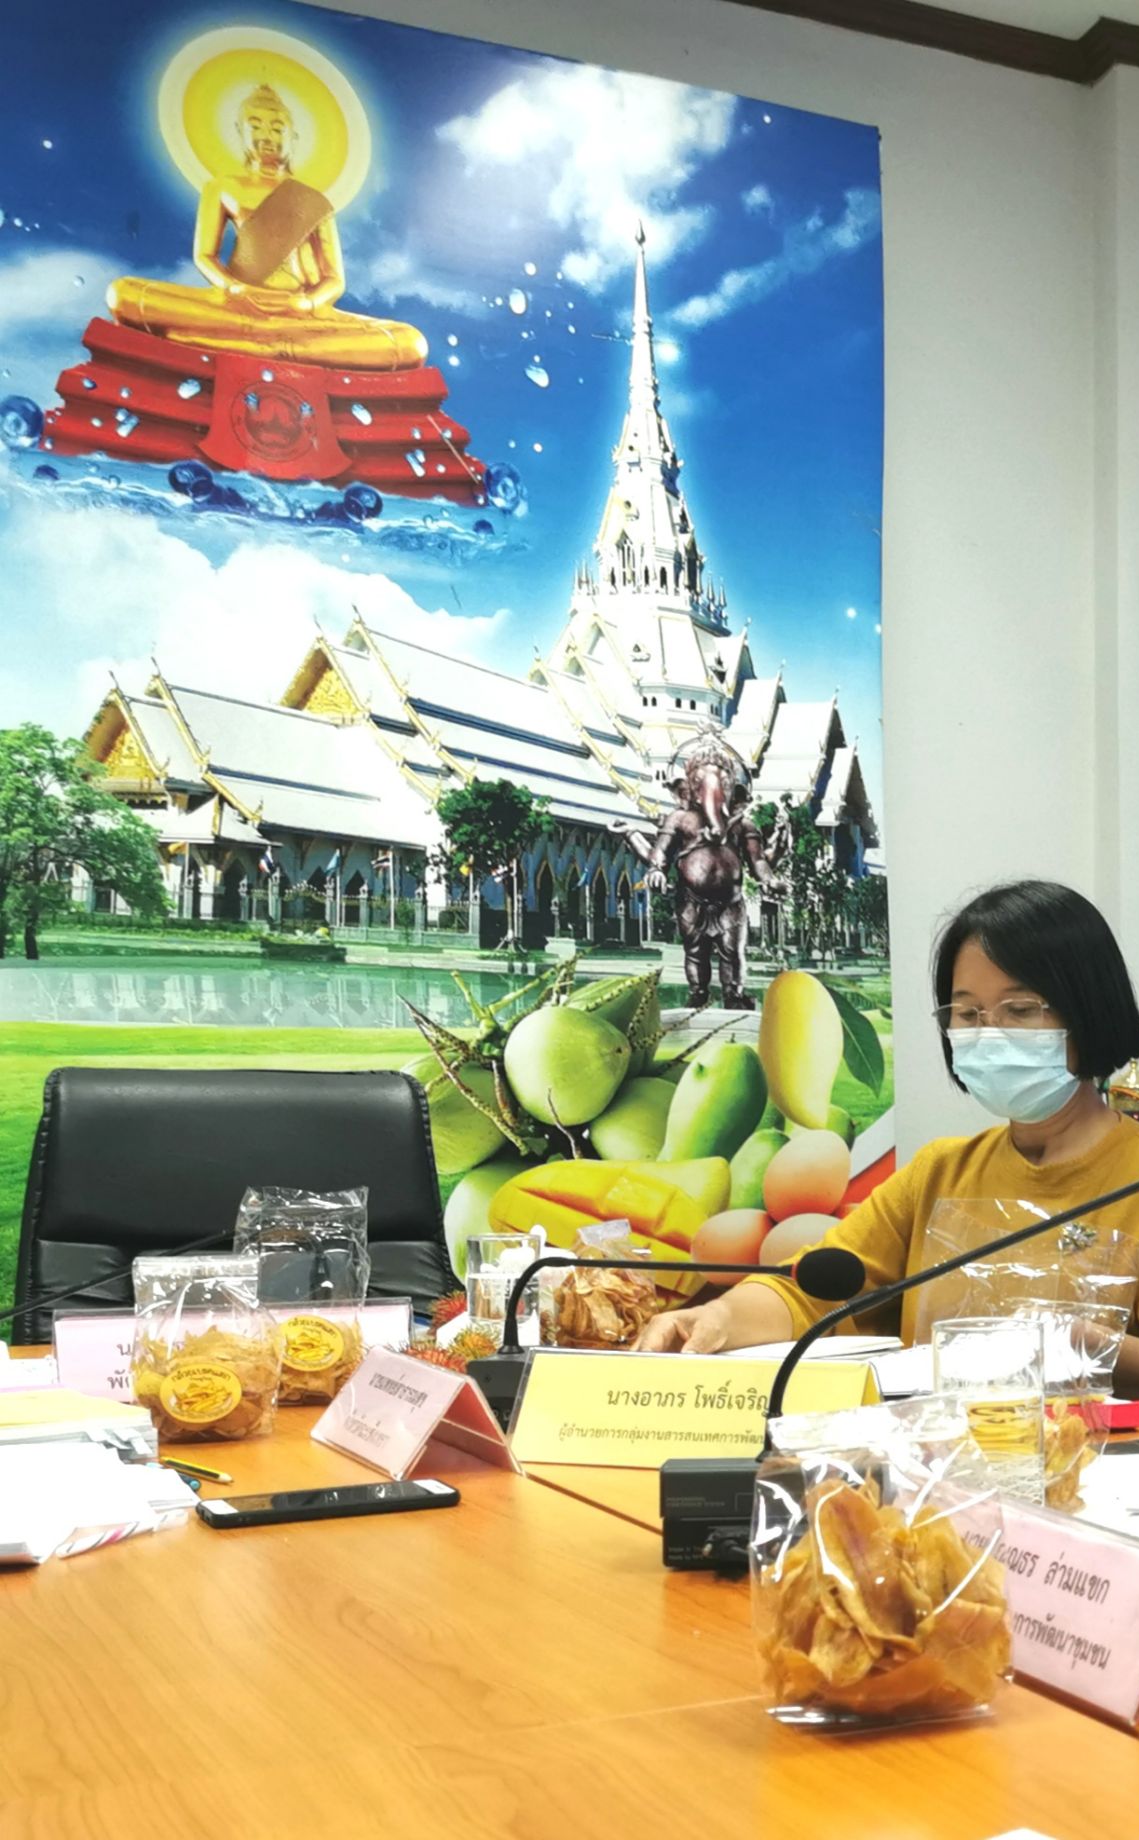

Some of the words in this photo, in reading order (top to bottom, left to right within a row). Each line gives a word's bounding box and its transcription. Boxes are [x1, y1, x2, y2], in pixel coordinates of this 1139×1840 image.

[606, 1387, 687, 1409] นางอาภร
[1043, 1551, 1111, 1605] ล่ามแขก
